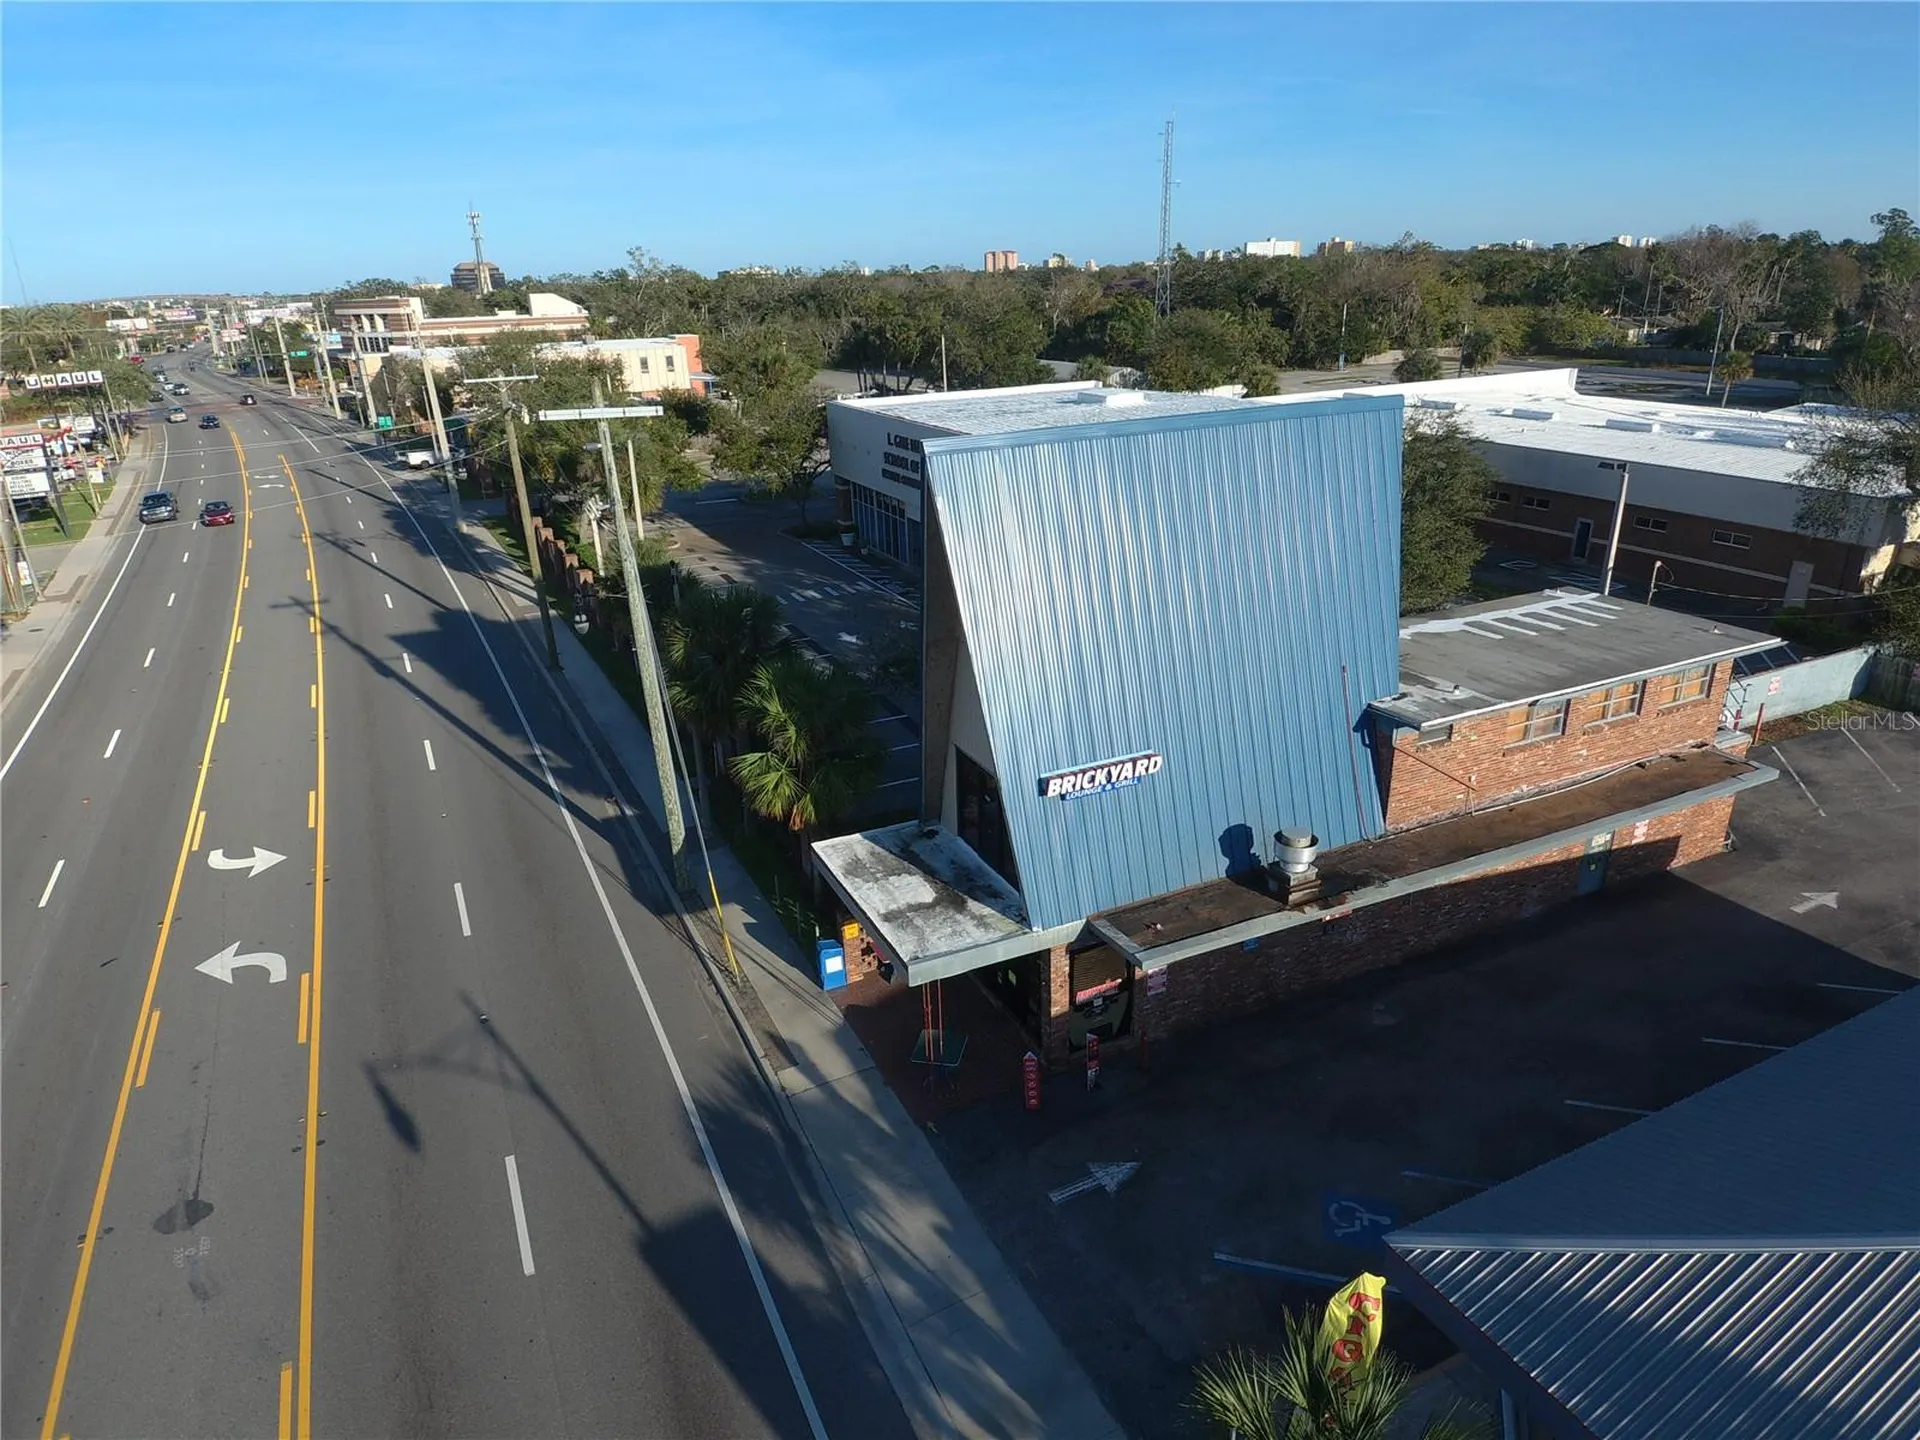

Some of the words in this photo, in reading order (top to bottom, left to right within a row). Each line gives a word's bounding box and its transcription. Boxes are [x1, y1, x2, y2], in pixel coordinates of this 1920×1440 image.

[1047, 756, 1162, 797] BRICKYARD
[1065, 785, 1103, 799] LOUNGE
[1114, 777, 1138, 788] GRILL
